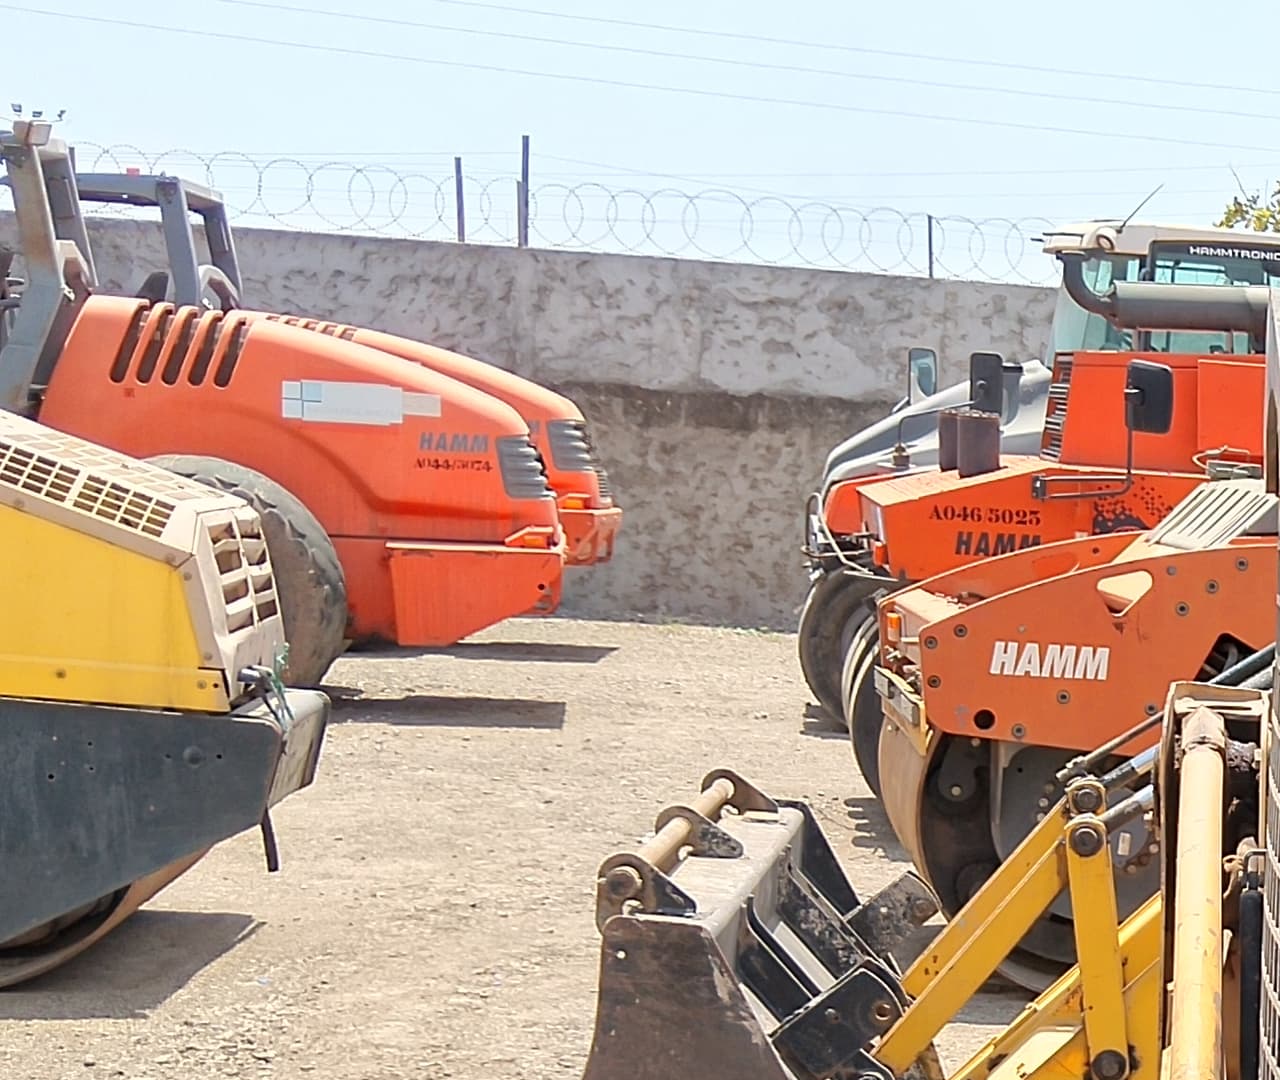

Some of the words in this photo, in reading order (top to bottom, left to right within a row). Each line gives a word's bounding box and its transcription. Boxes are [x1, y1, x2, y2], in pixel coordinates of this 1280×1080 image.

[419, 432, 489, 453] HAMM
[955, 531, 1041, 557] HAMM
[990, 641, 1110, 680] HAMM
